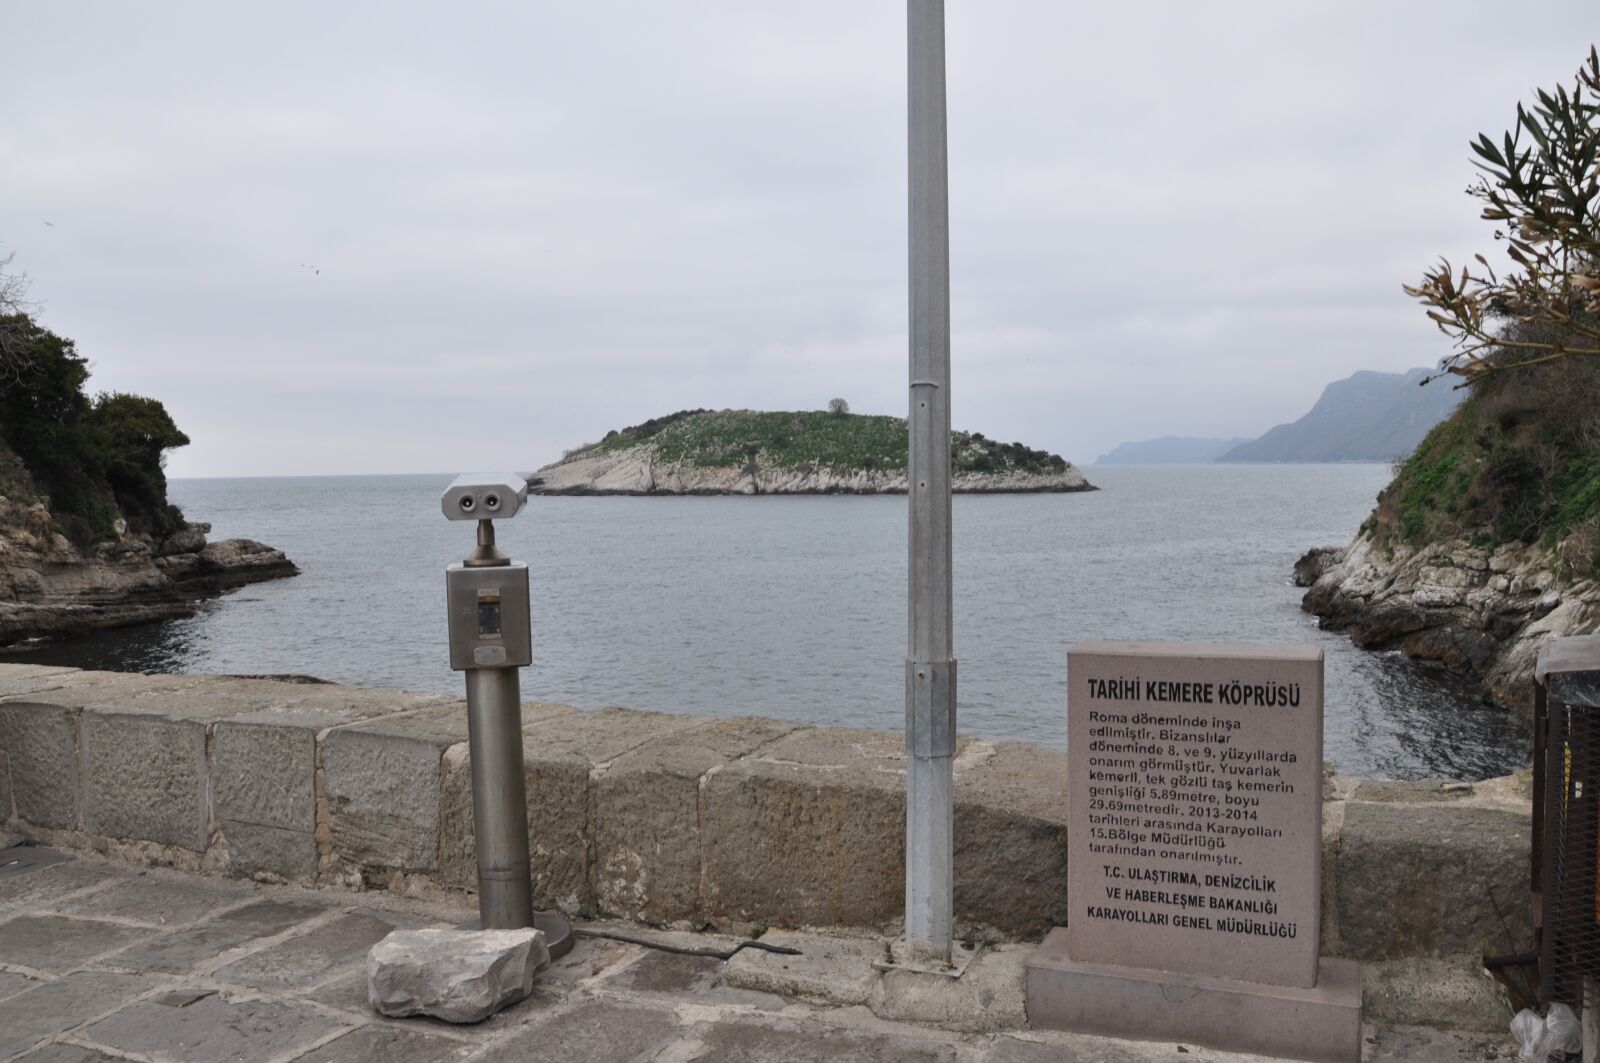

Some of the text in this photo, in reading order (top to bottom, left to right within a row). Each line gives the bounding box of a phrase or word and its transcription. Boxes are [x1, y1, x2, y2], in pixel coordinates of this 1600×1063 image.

[1088, 676, 1300, 708] TARİHİ KEMERE KÖPRÜSÜ
[1090, 711, 1241, 730] Roma döneminde inşa
[1090, 727, 1231, 744] edilmiştir. Bizanslılar
[1090, 742, 1296, 763] döneminde 8. ve 9. yüzyıllarda
[1090, 757, 1280, 777] onarım görmüştür. Yuvarlak
[1146, 774, 1165, 785] tek
[1171, 775, 1207, 789] gözlü
[1212, 779, 1232, 791] taş
[1238, 780, 1294, 794] kemerin
[1090, 785, 1145, 799] genişliği
[1225, 795, 1259, 808] boyu
[1189, 807, 1257, 820] 2013-2014
[1089, 814, 1282, 838] tarihleri arasında Karayolları
[1090, 828, 1225, 849] 15.Bölge Müdürlüğü
[1089, 843, 1242, 865] tarafından onarılmıştır.
[1104, 866, 1275, 892] T.C. ULAŞTIRMA, DENİZCİLİK
[1106, 887, 1277, 914] VE HABERLEŞME BAKANLIĞI
[1088, 906, 1297, 939] KARAYOLLARI GENEL MÜDÜRLÜĞÜ
